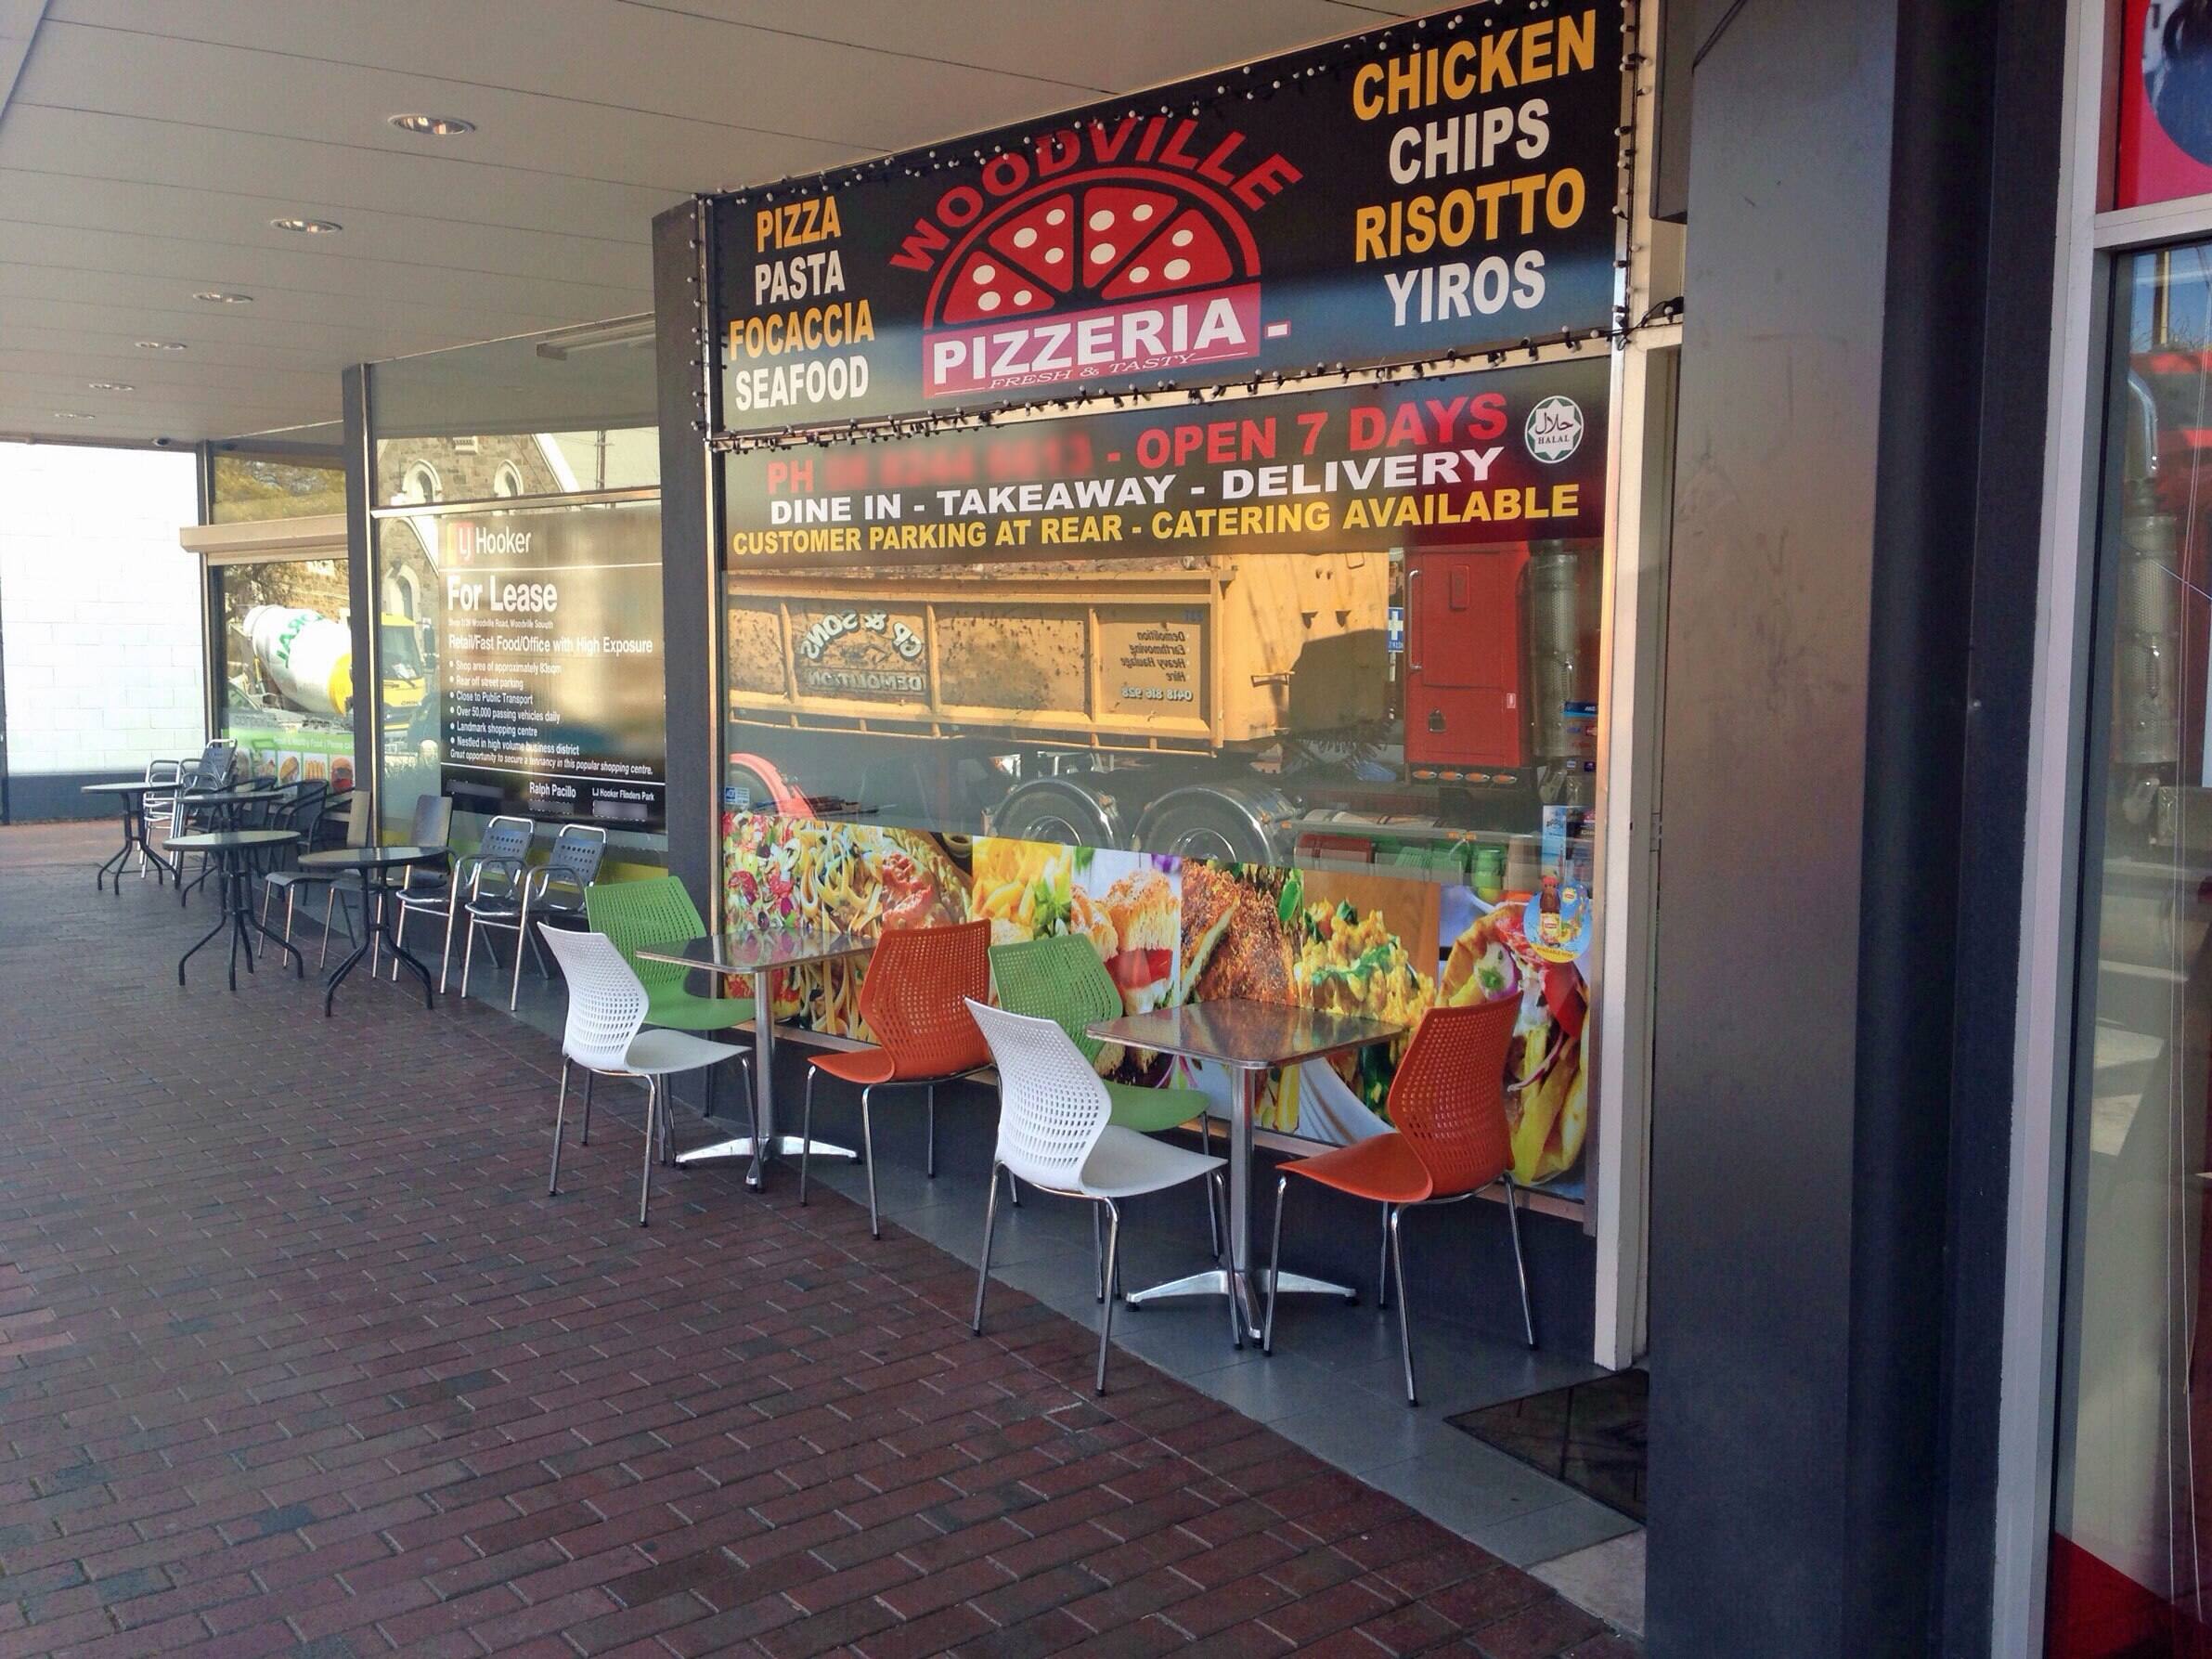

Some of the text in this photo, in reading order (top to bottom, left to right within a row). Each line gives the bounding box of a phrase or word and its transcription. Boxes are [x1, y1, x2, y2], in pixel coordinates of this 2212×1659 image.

[1353, 9, 1596, 121] CHICKEN
[1389, 97, 1549, 185] CHIPS
[890, 117, 1303, 272] WOODVILLE
[757, 196, 842, 253] PIZZA
[1355, 168, 1585, 263] RISOTTO
[755, 251, 845, 305] PASTA
[1384, 250, 1546, 327] YIROS
[730, 300, 874, 360] FOCACCIA
[934, 298, 1246, 384] PIZZERIA
[736, 356, 869, 410] SEAFOOD
[988, 353, 1197, 389] FRESH & TASTY
[768, 460, 813, 495] PH
[1135, 417, 1275, 468] OPEN
[1297, 411, 1328, 456] 7
[1350, 393, 1507, 451] DAYS
[1538, 435, 1570, 444] HALAL
[770, 496, 851, 525] DINE
[864, 493, 901, 521] IN
[937, 473, 1176, 517] TAKEAWAY
[1222, 447, 1505, 500] DELIVERY
[733, 522, 861, 555] CUSTOMER
[870, 518, 987, 551] PARKING
[995, 519, 1032, 546] AT
[1041, 513, 1122, 544] REAR
[1152, 501, 1330, 539] CATERING
[1342, 485, 1579, 530] AVAILABLE
[475, 526, 531, 554] Hooker
[446, 575, 558, 613] For Lease
[448, 633, 653, 657] Retail/Fast Food/Office with High Exposure
[456, 660, 472, 673] Shop
[472, 662, 485, 671] area
[487, 660, 494, 672] of
[472, 676, 481, 686] off
[481, 677, 499, 688] street
[500, 678, 524, 691] parking
[456, 691, 534, 706] Close to Public Transport
[457, 706, 561, 724] Over 50,000 passing vehicles daily
[457, 720, 538, 737] Landmark shopping centre
[457, 736, 580, 757] Nestled in high volume business district
[466, 750, 497, 763] opportunity
[498, 753, 504, 762] to
[505, 755, 523, 764] secure
[557, 758, 563, 768] in
[563, 758, 575, 769] this
[576, 760, 600, 771] popular
[601, 761, 629, 775] shopping
[631, 764, 653, 775] centre.
[529, 782, 550, 797] Ralph
[600, 788, 618, 798] Hooker
[619, 789, 640, 800] Flinders
[642, 791, 654, 801] Park
